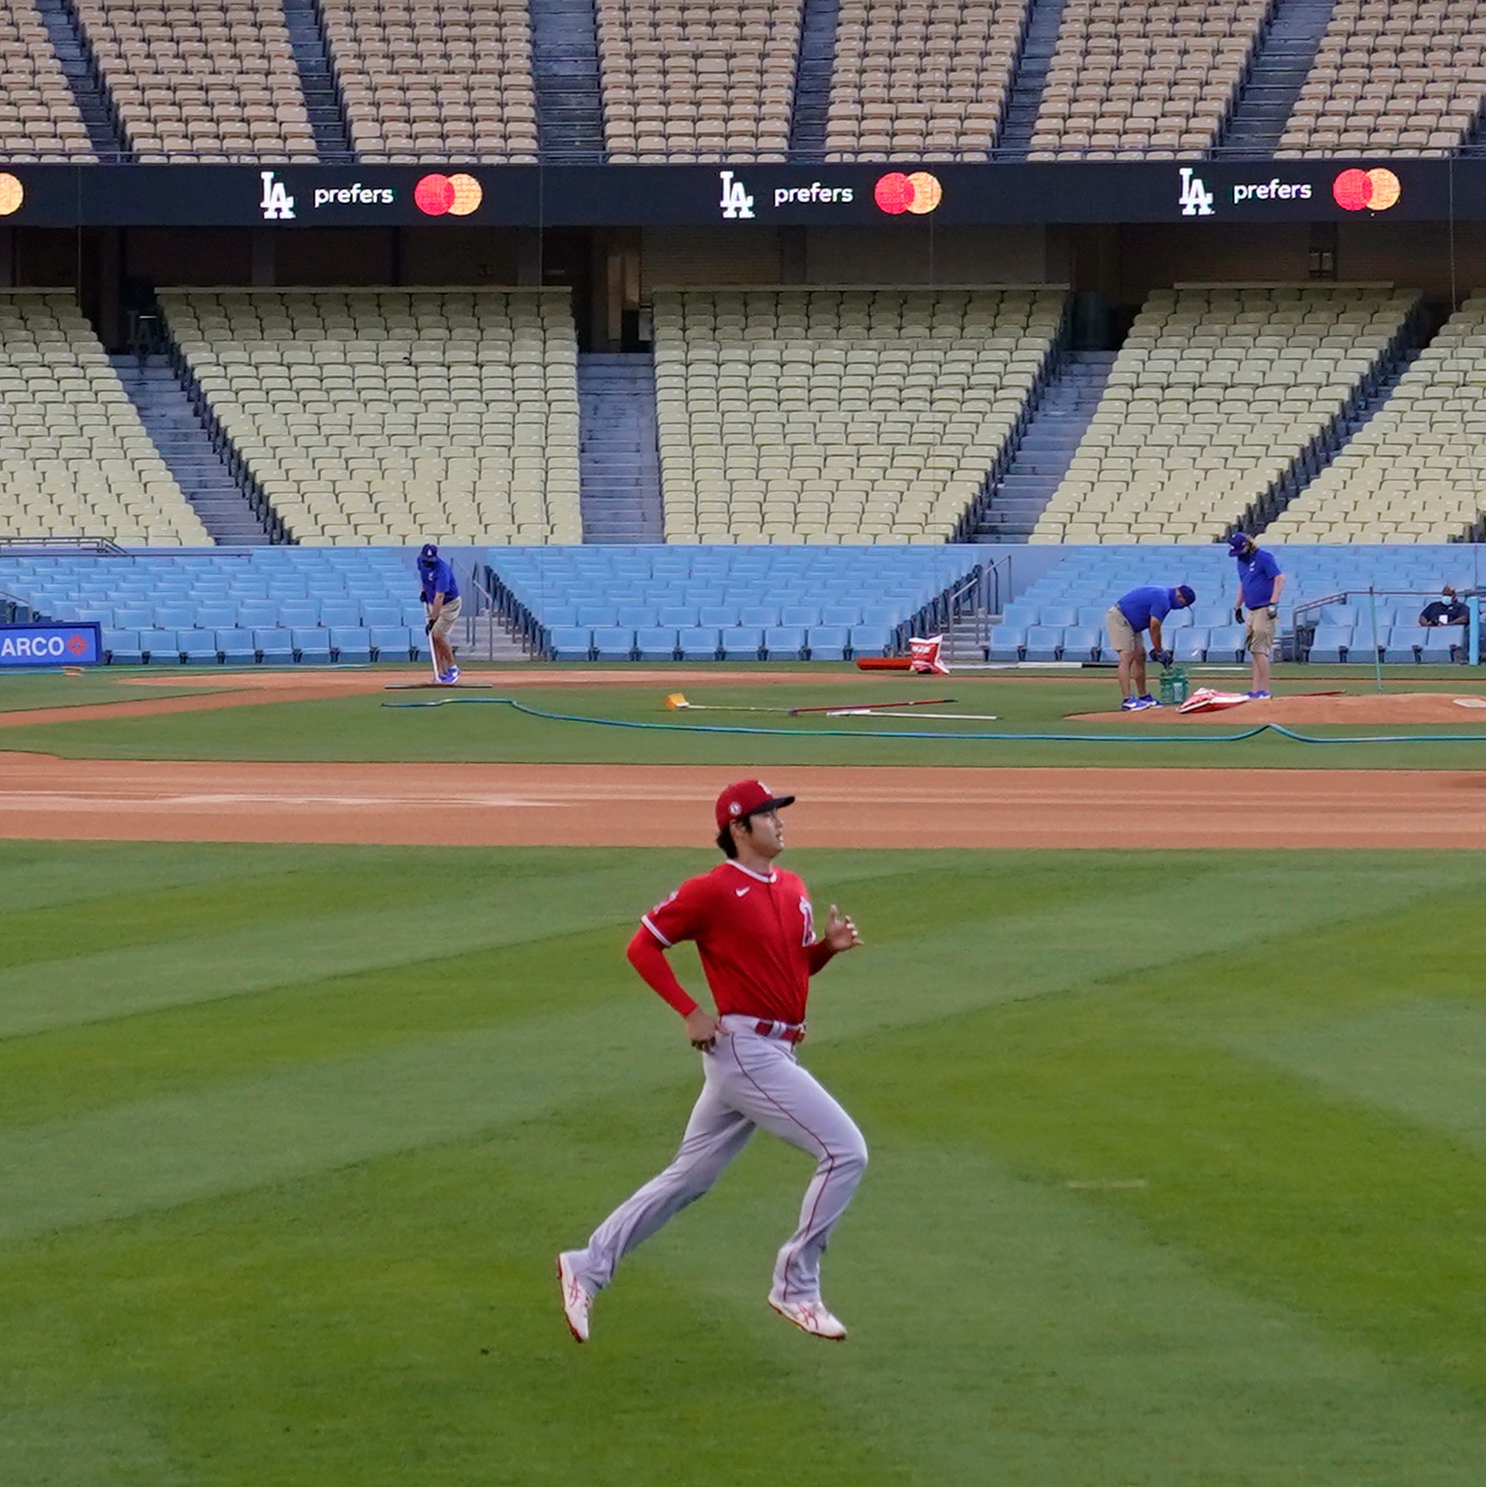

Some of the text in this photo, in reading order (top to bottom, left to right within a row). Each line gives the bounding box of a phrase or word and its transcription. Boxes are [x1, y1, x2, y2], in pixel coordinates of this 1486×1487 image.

[260, 172, 393, 220] LA prefers
[720, 171, 853, 219] LA prefers
[1179, 167, 1312, 216] LA prefers
[1, 636, 65, 657] ARCO
